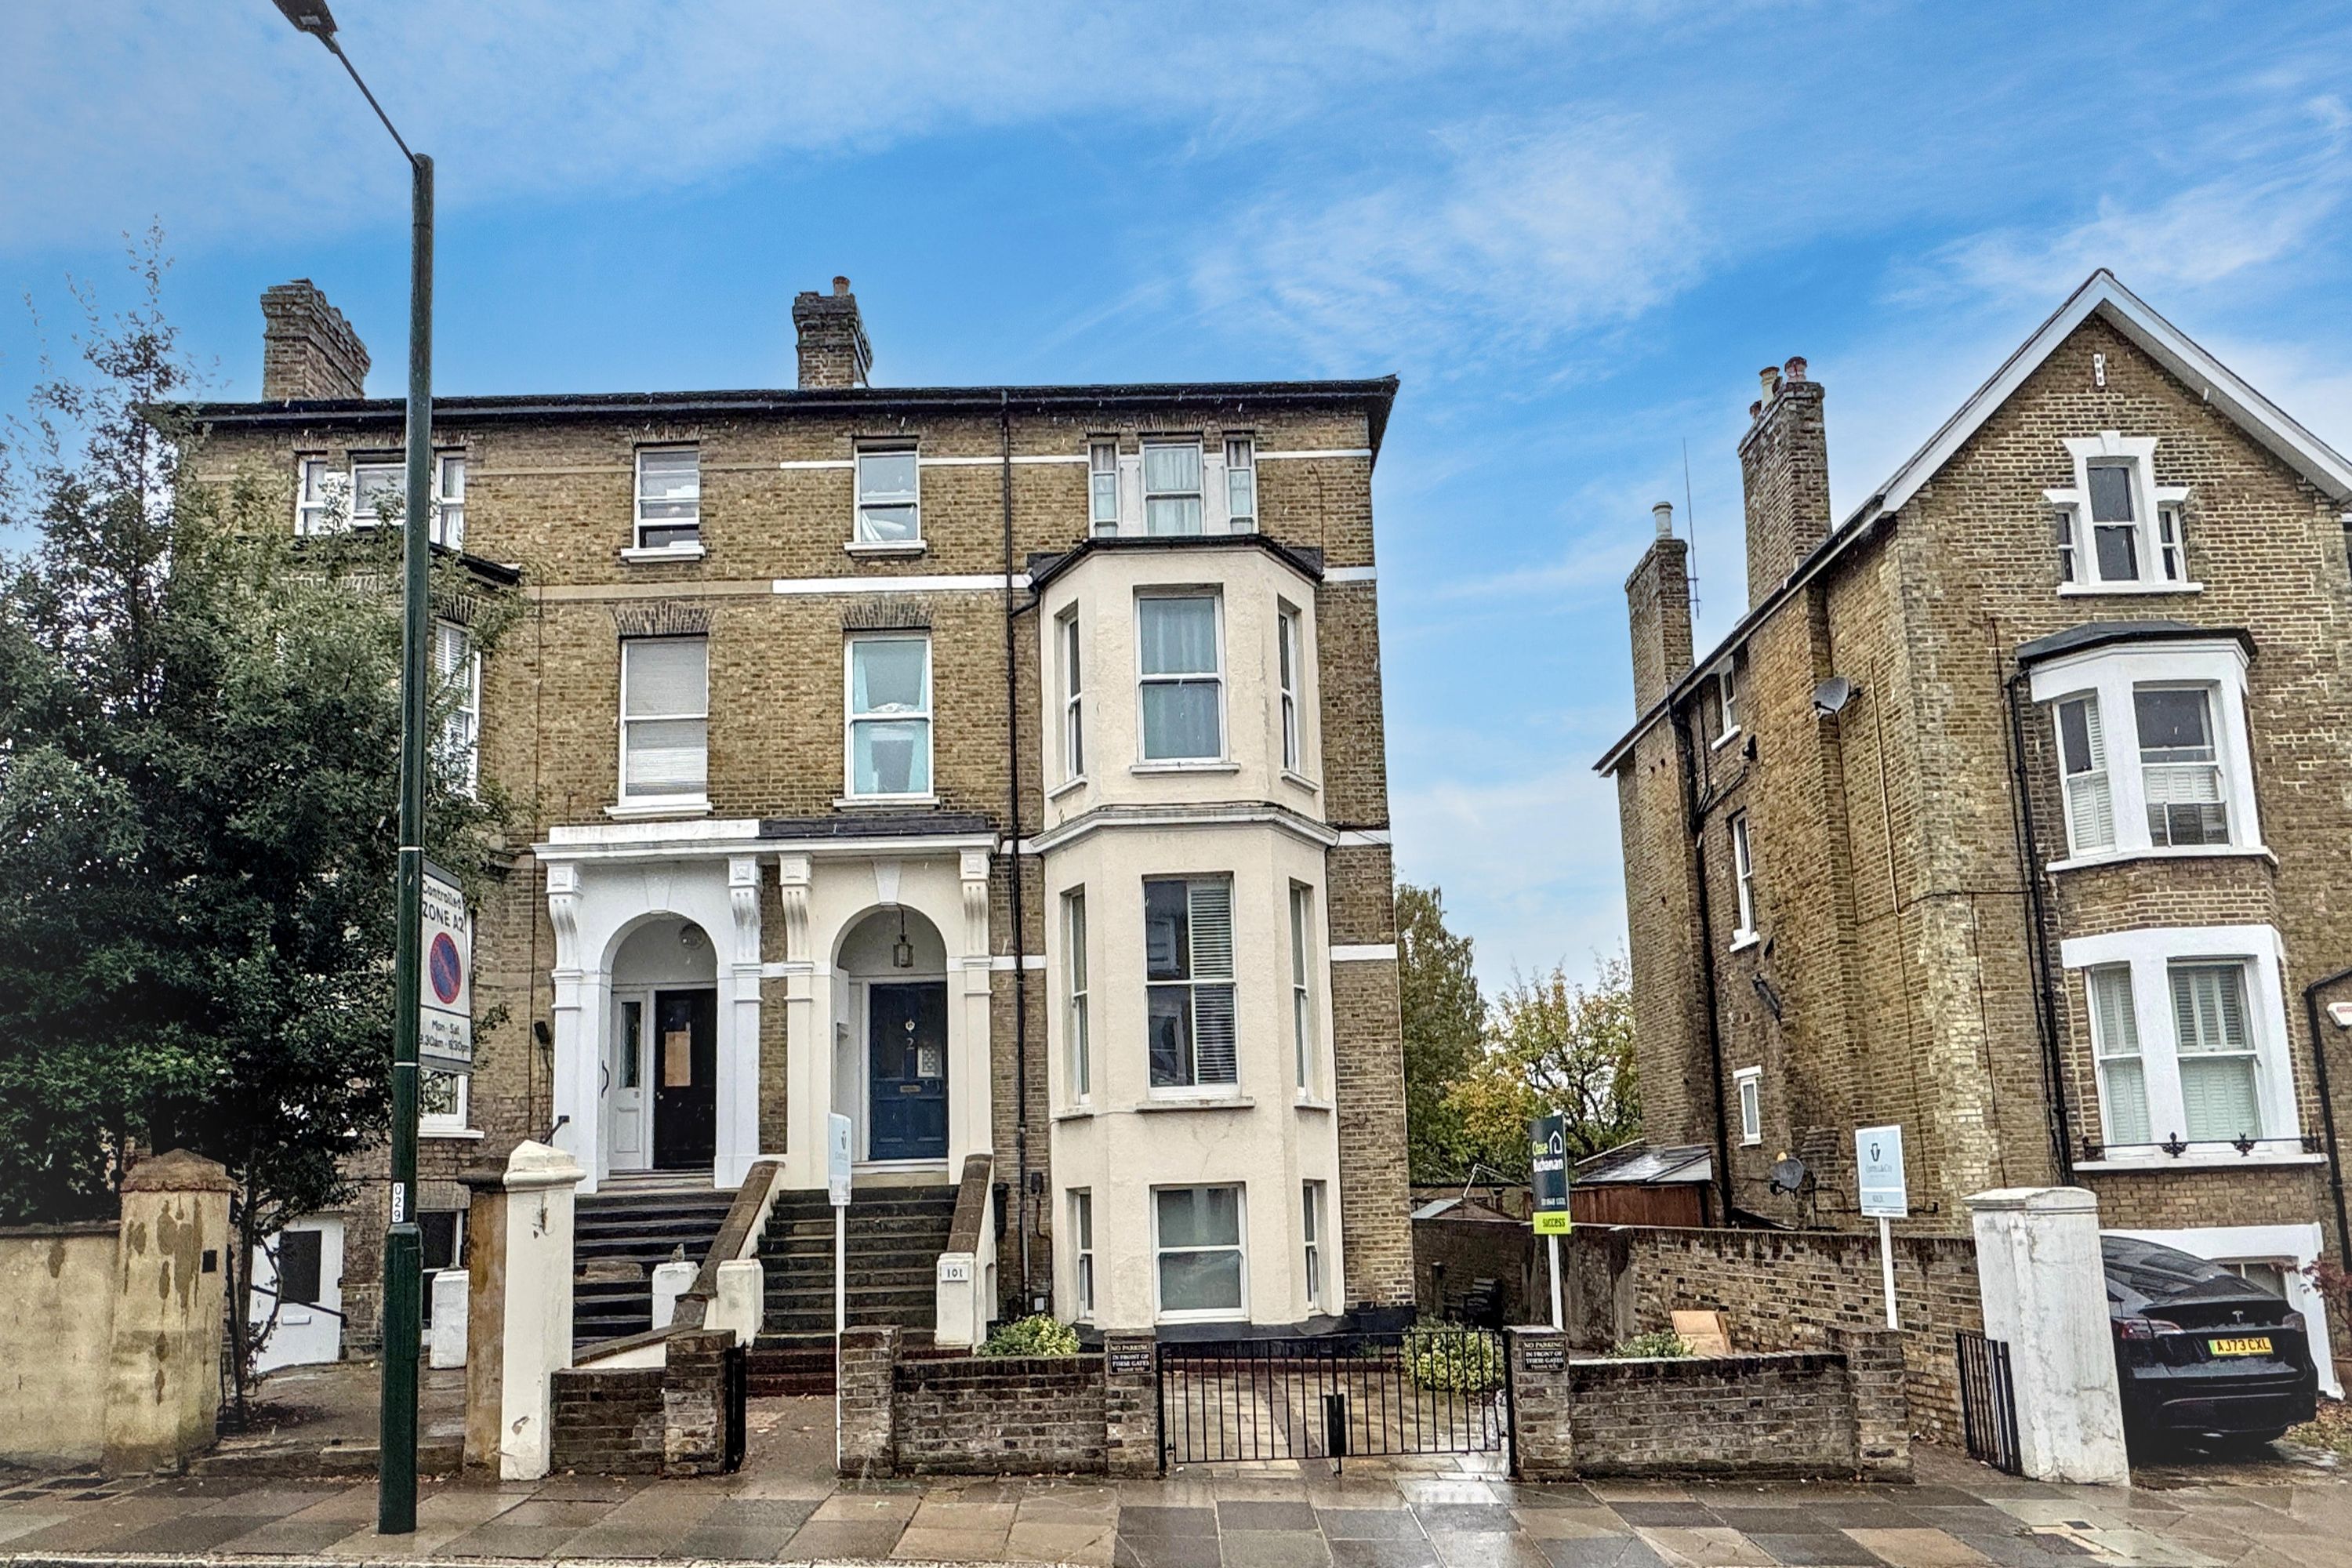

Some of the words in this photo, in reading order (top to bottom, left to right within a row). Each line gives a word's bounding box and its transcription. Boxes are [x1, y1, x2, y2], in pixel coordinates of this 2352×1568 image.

[422, 880, 461, 909] Controlled
[423, 901, 450, 927] ZONE
[453, 914, 464, 933] A2
[432, 1020, 445, 1031] Mon
[947, 1269, 963, 1278] 101
[2217, 1339, 2246, 1352] AJ73
[2248, 1338, 2270, 1350] CXL
